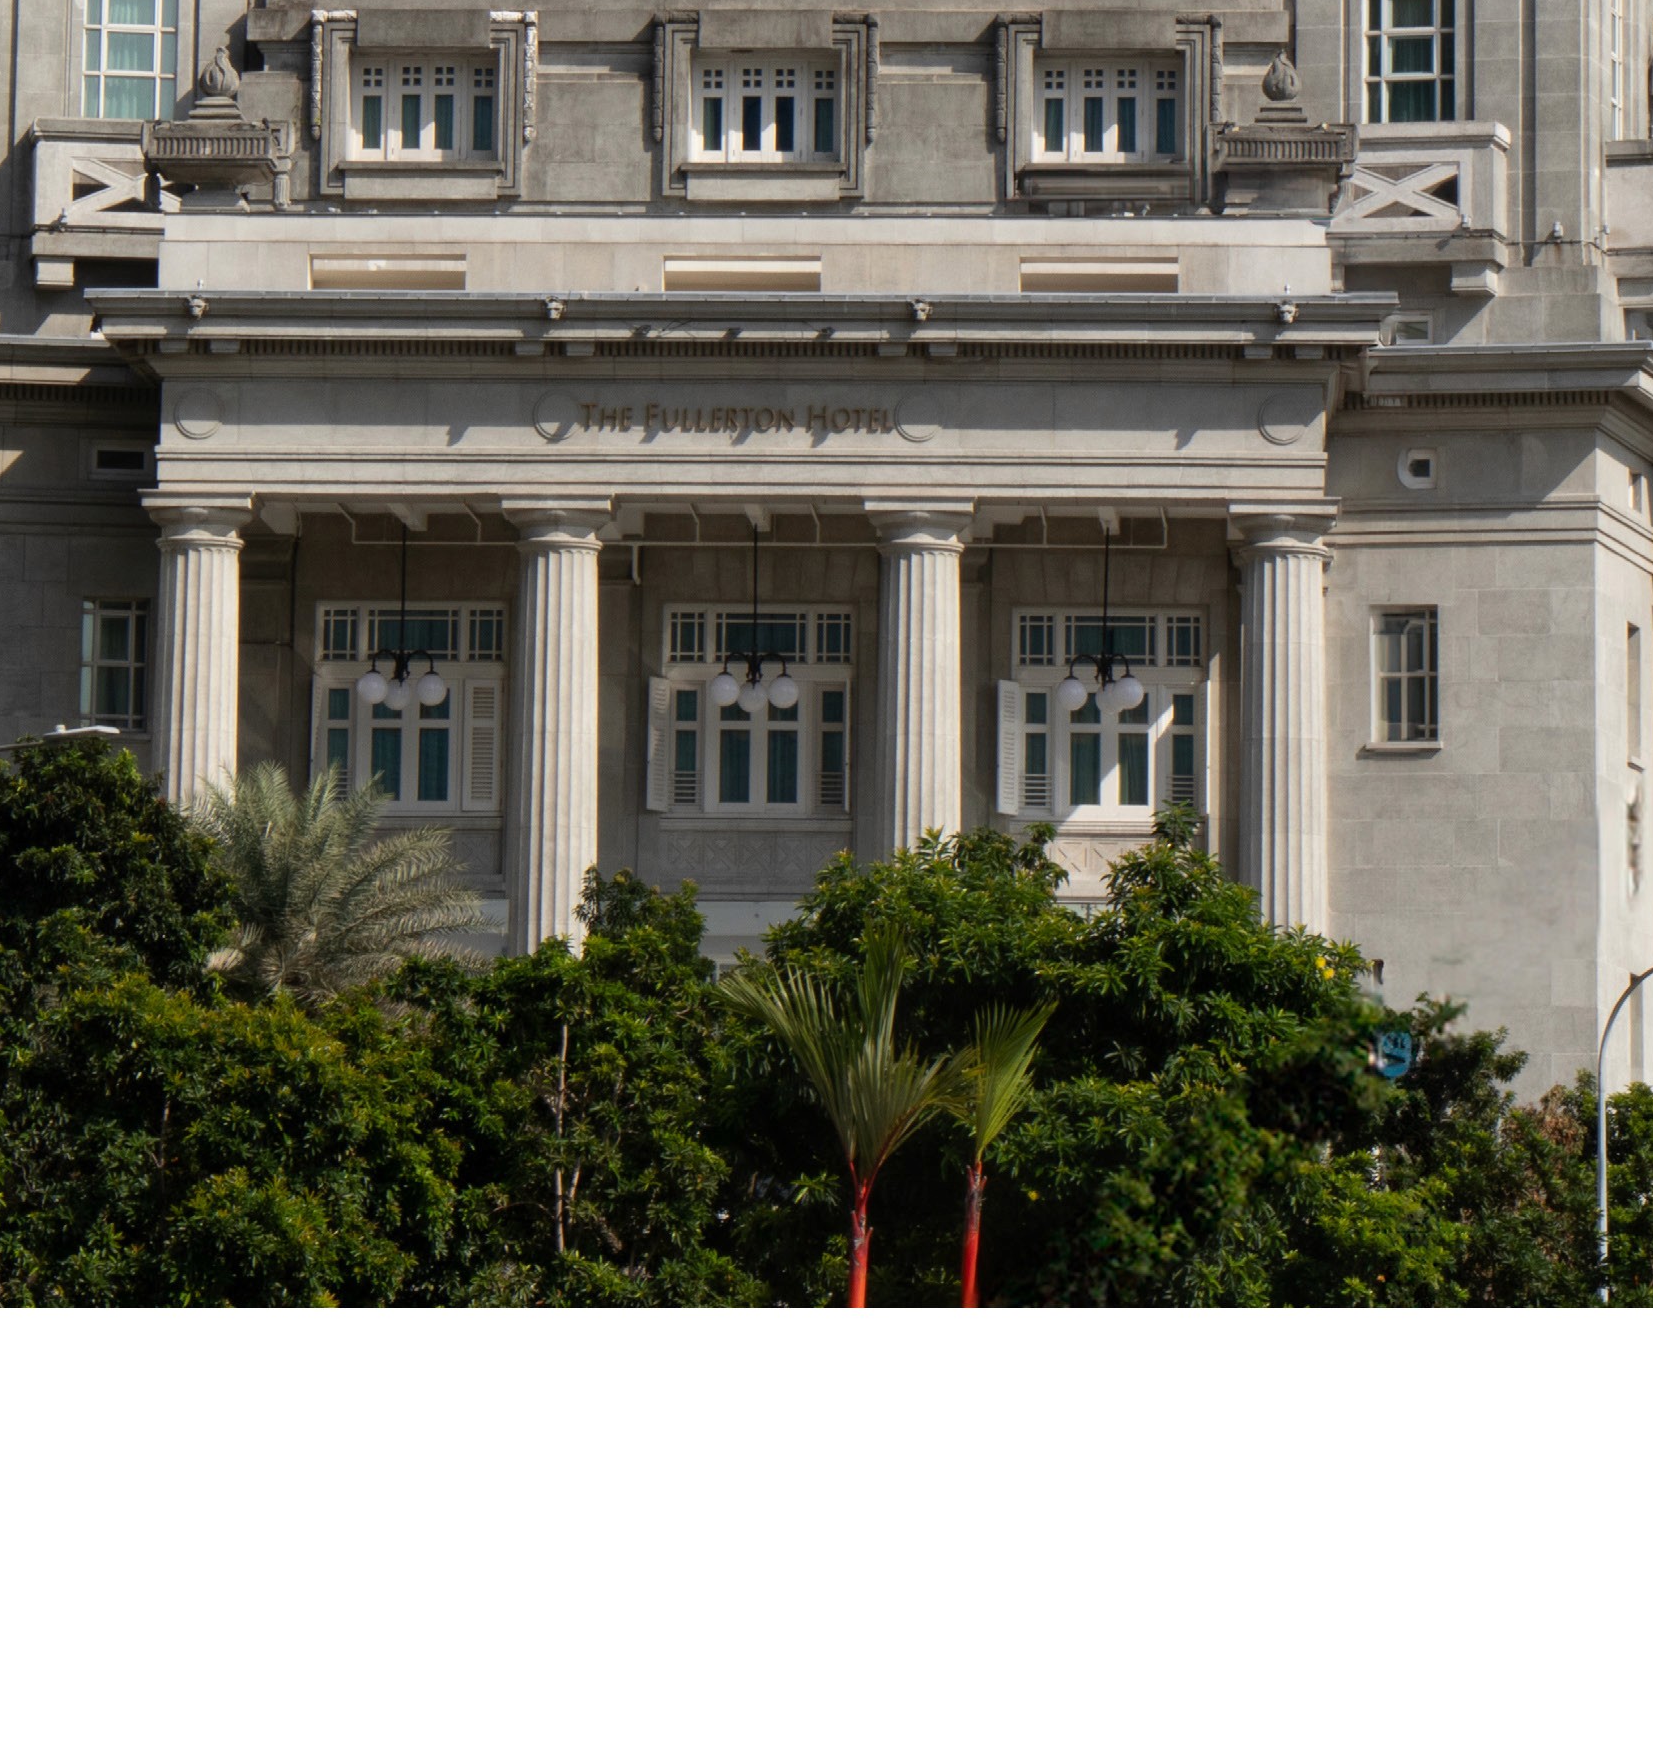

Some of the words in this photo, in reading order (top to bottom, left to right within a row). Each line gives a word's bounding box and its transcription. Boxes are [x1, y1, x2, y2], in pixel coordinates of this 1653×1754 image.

[580, 403, 633, 433] THE
[645, 403, 795, 433] FULLERTON
[806, 404, 895, 434] HOTEL
